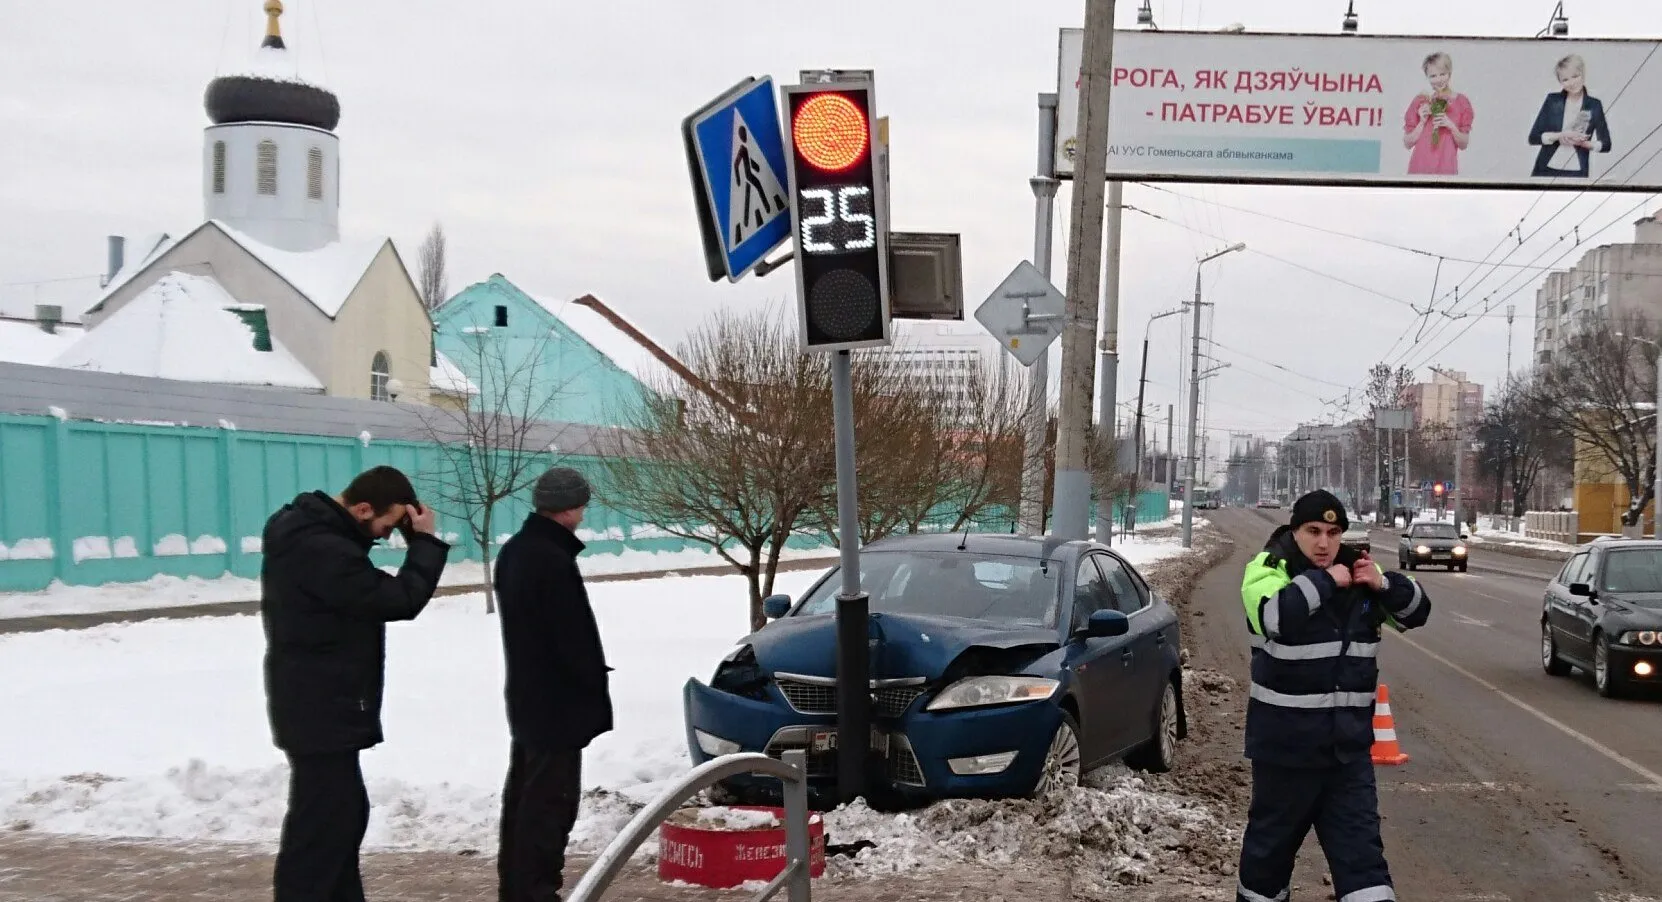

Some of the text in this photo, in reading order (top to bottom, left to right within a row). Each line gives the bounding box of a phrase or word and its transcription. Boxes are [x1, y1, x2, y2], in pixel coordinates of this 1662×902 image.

[1075, 66, 1384, 94] РОГА, ЯК ДЗЯЎЧЫНА
[1160, 102, 1295, 126] ПАТРАБУЕ
[1302, 101, 1384, 128] ЎВАГІ!
[1122, 145, 1145, 157] УУС
[1147, 146, 1214, 159] Гомельскага
[1216, 148, 1294, 161] аблвыканкама
[800, 186, 875, 253] 25
